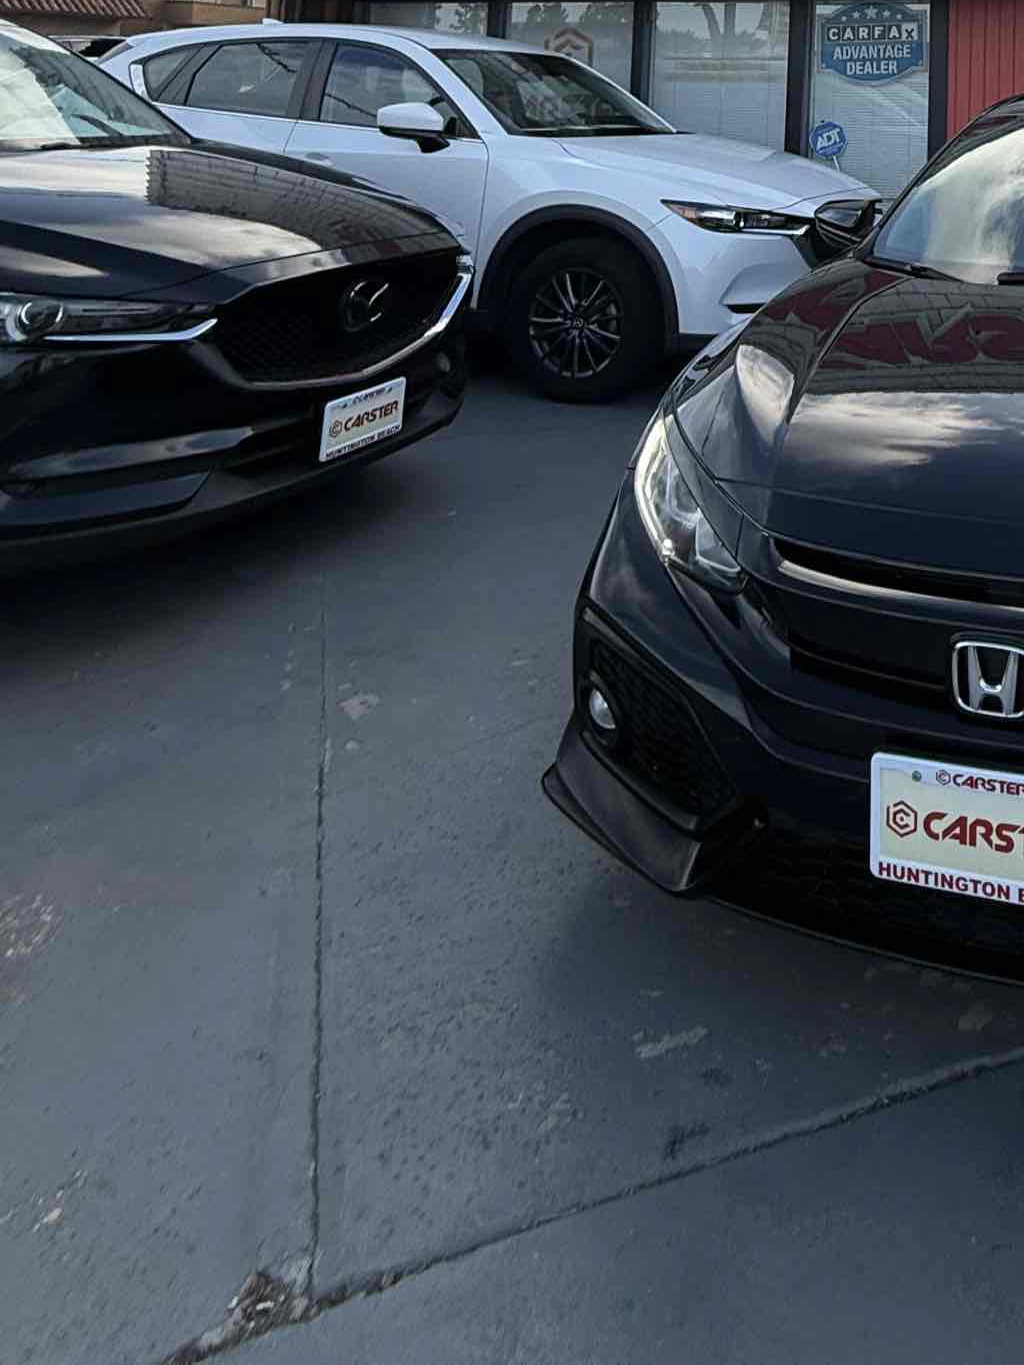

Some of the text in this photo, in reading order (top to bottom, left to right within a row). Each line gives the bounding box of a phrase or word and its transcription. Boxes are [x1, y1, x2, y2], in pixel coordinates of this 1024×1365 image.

[828, 25, 918, 42] CARFAX
[833, 44, 912, 60] ADVANTAGE
[846, 60, 898, 75] DEALER
[816, 128, 841, 151] ADT
[344, 400, 399, 432] CARSTER
[877, 861, 1011, 901] HUNTINGTON
